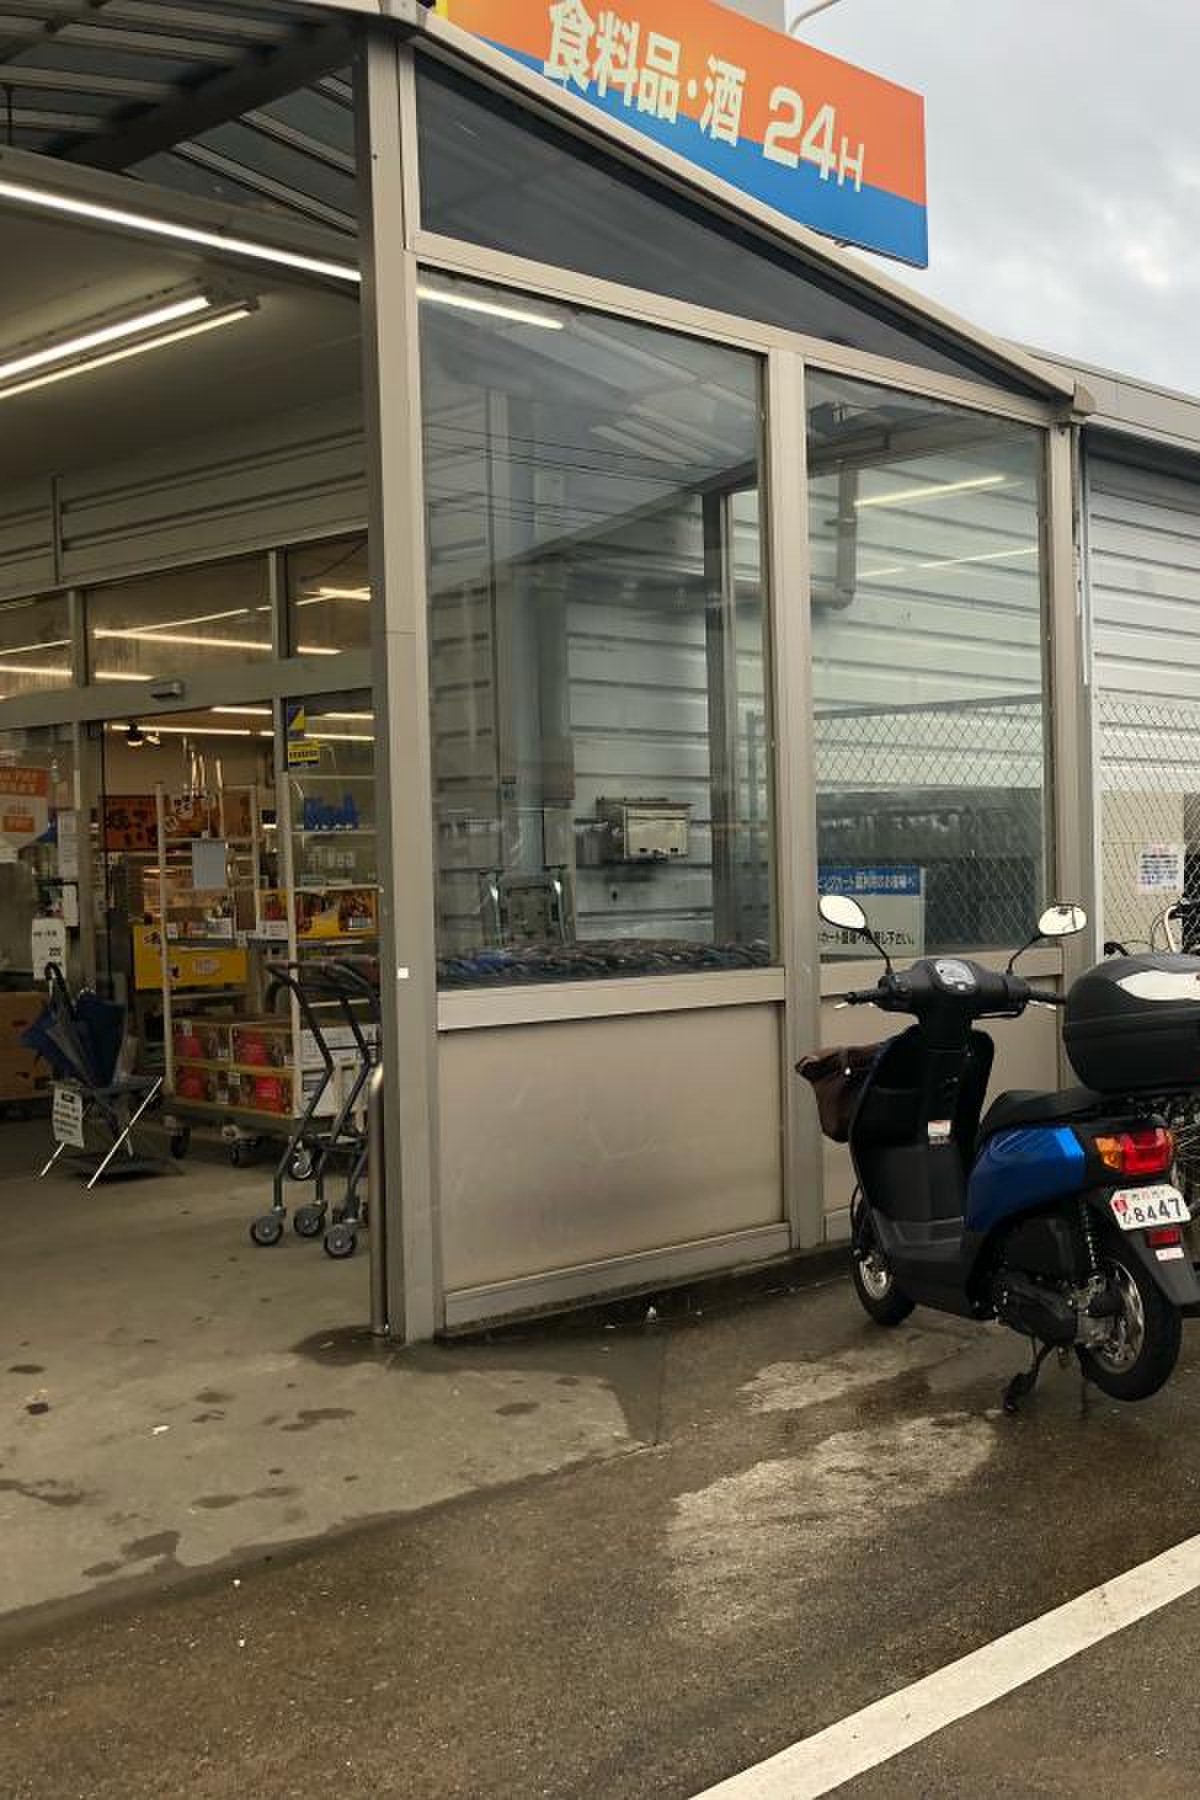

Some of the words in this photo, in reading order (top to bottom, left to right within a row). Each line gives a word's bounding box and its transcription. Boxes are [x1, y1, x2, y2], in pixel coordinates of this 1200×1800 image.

[544, 0, 747, 147] 食料品・酒
[763, 86, 865, 193] 24H
[1134, 1199, 1181, 1222] 8447
